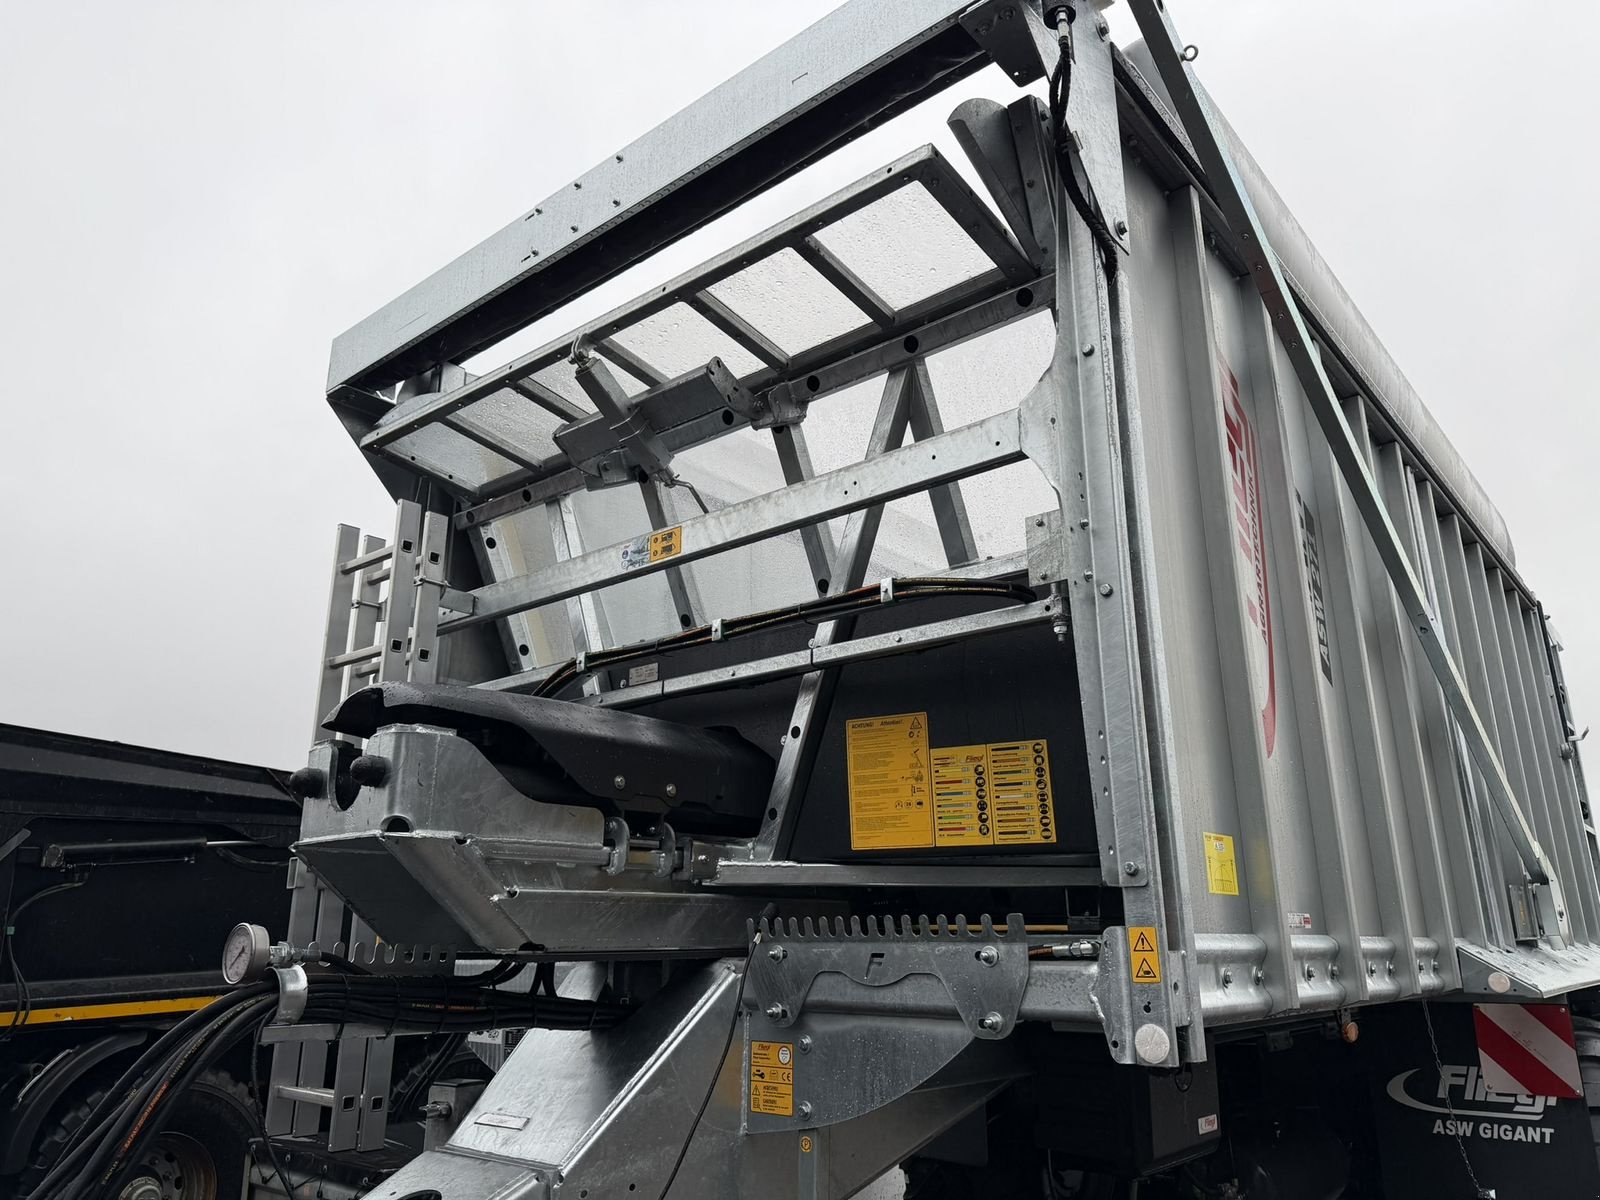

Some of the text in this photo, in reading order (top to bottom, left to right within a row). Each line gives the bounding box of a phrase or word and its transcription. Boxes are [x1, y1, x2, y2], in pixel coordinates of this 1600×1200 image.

[1247, 472, 1267, 647] AGRARTECHNIK
[1314, 591, 1331, 666] ASW
[1432, 1119, 1555, 1144] ASW GIGANT
